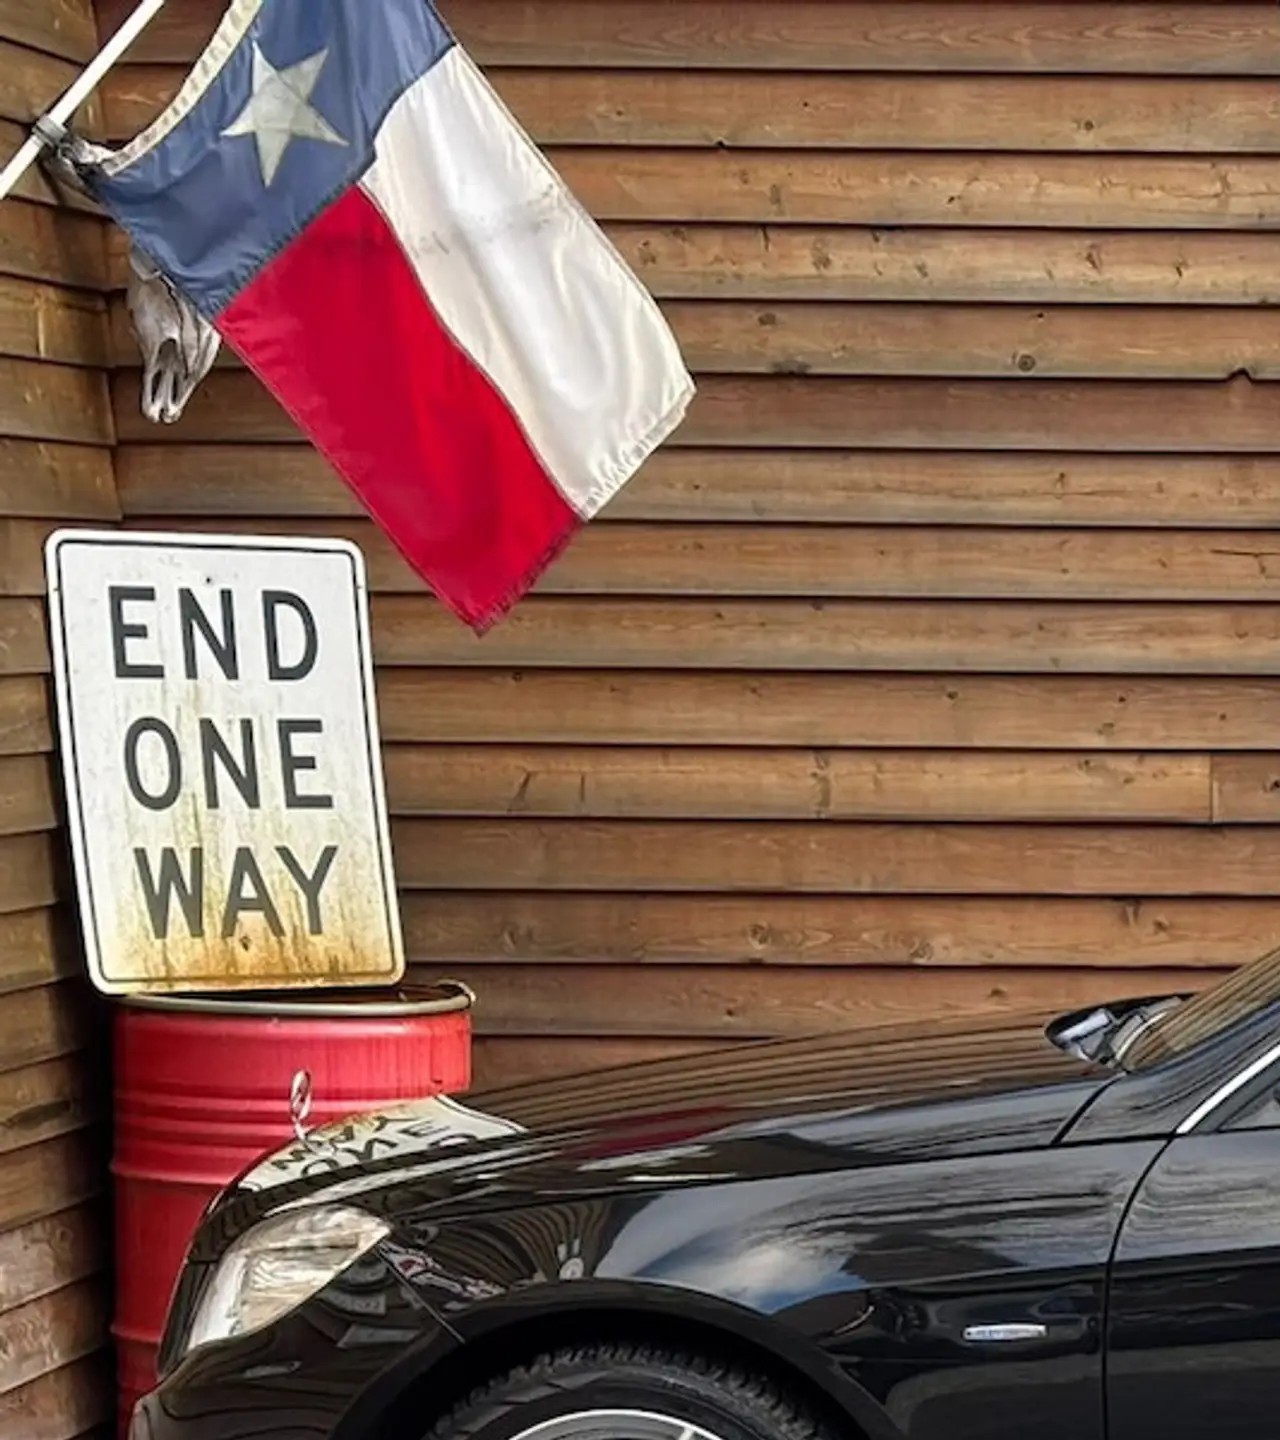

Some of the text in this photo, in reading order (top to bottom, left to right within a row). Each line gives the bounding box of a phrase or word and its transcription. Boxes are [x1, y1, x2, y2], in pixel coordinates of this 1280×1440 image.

[107, 584, 320, 682] END
[123, 716, 334, 811] ONE
[133, 845, 339, 940] WAY
